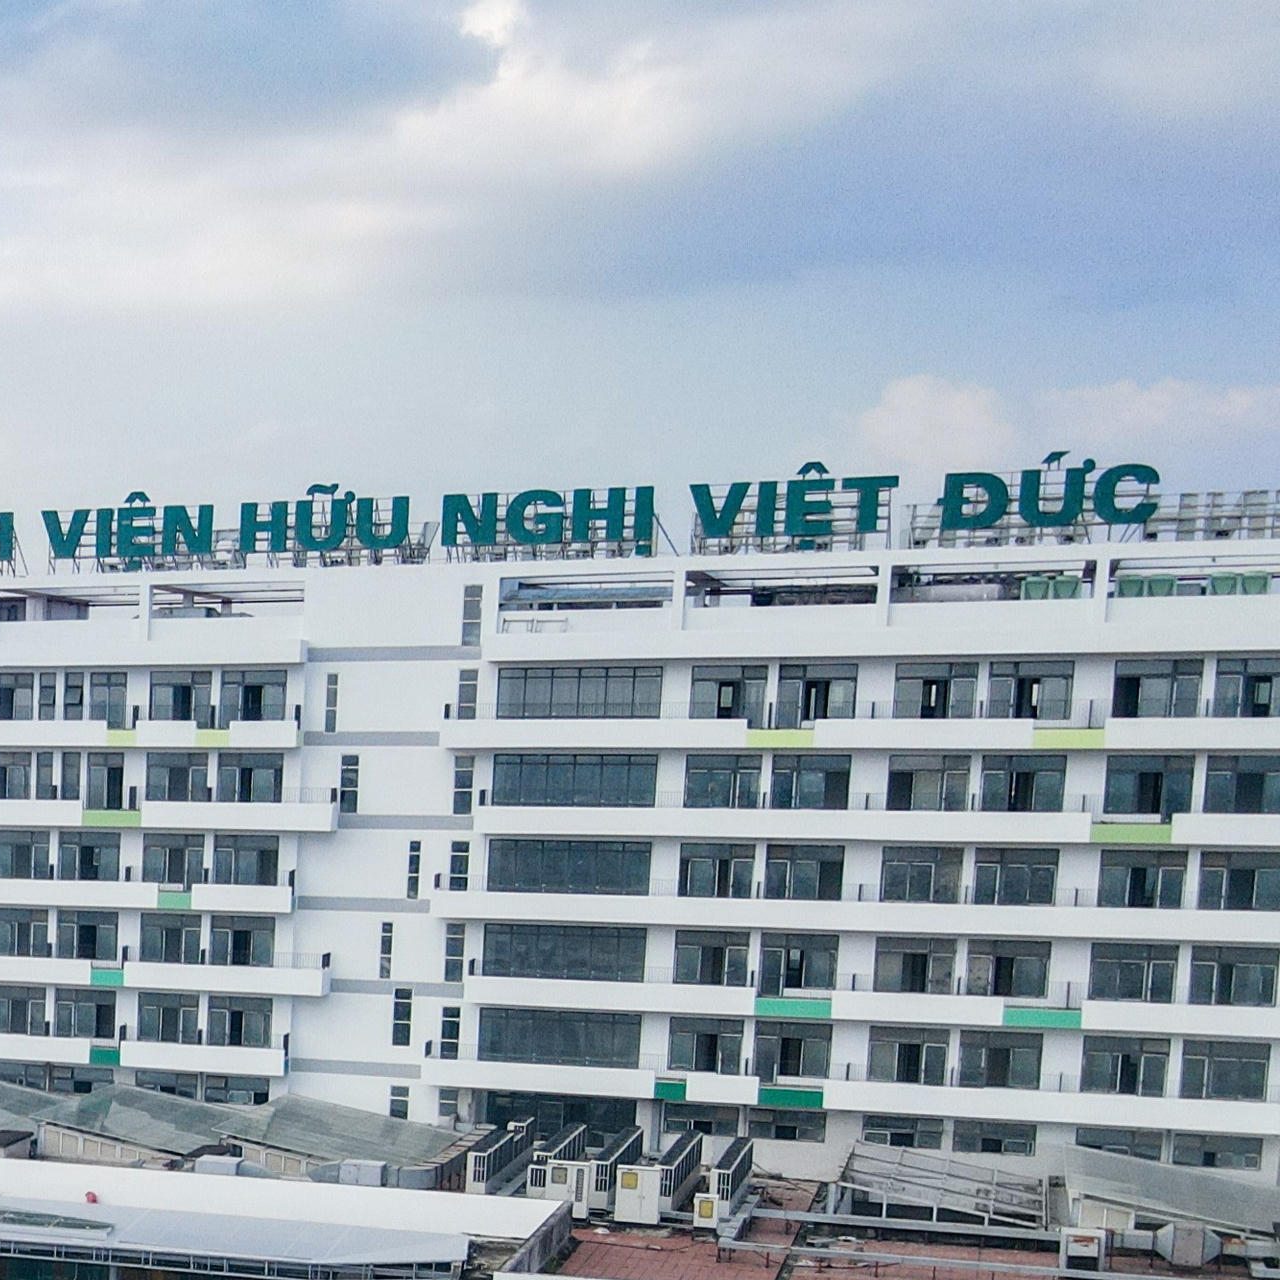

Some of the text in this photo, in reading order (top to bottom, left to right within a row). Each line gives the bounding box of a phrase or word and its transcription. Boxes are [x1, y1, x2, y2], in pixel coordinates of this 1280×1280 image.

[41, 491, 214, 573] VIỆN
[240, 483, 410, 553] HỮU
[440, 485, 655, 556] NGHỊ
[689, 461, 899, 550] VIỆT
[936, 451, 1161, 530] ĐỨC
